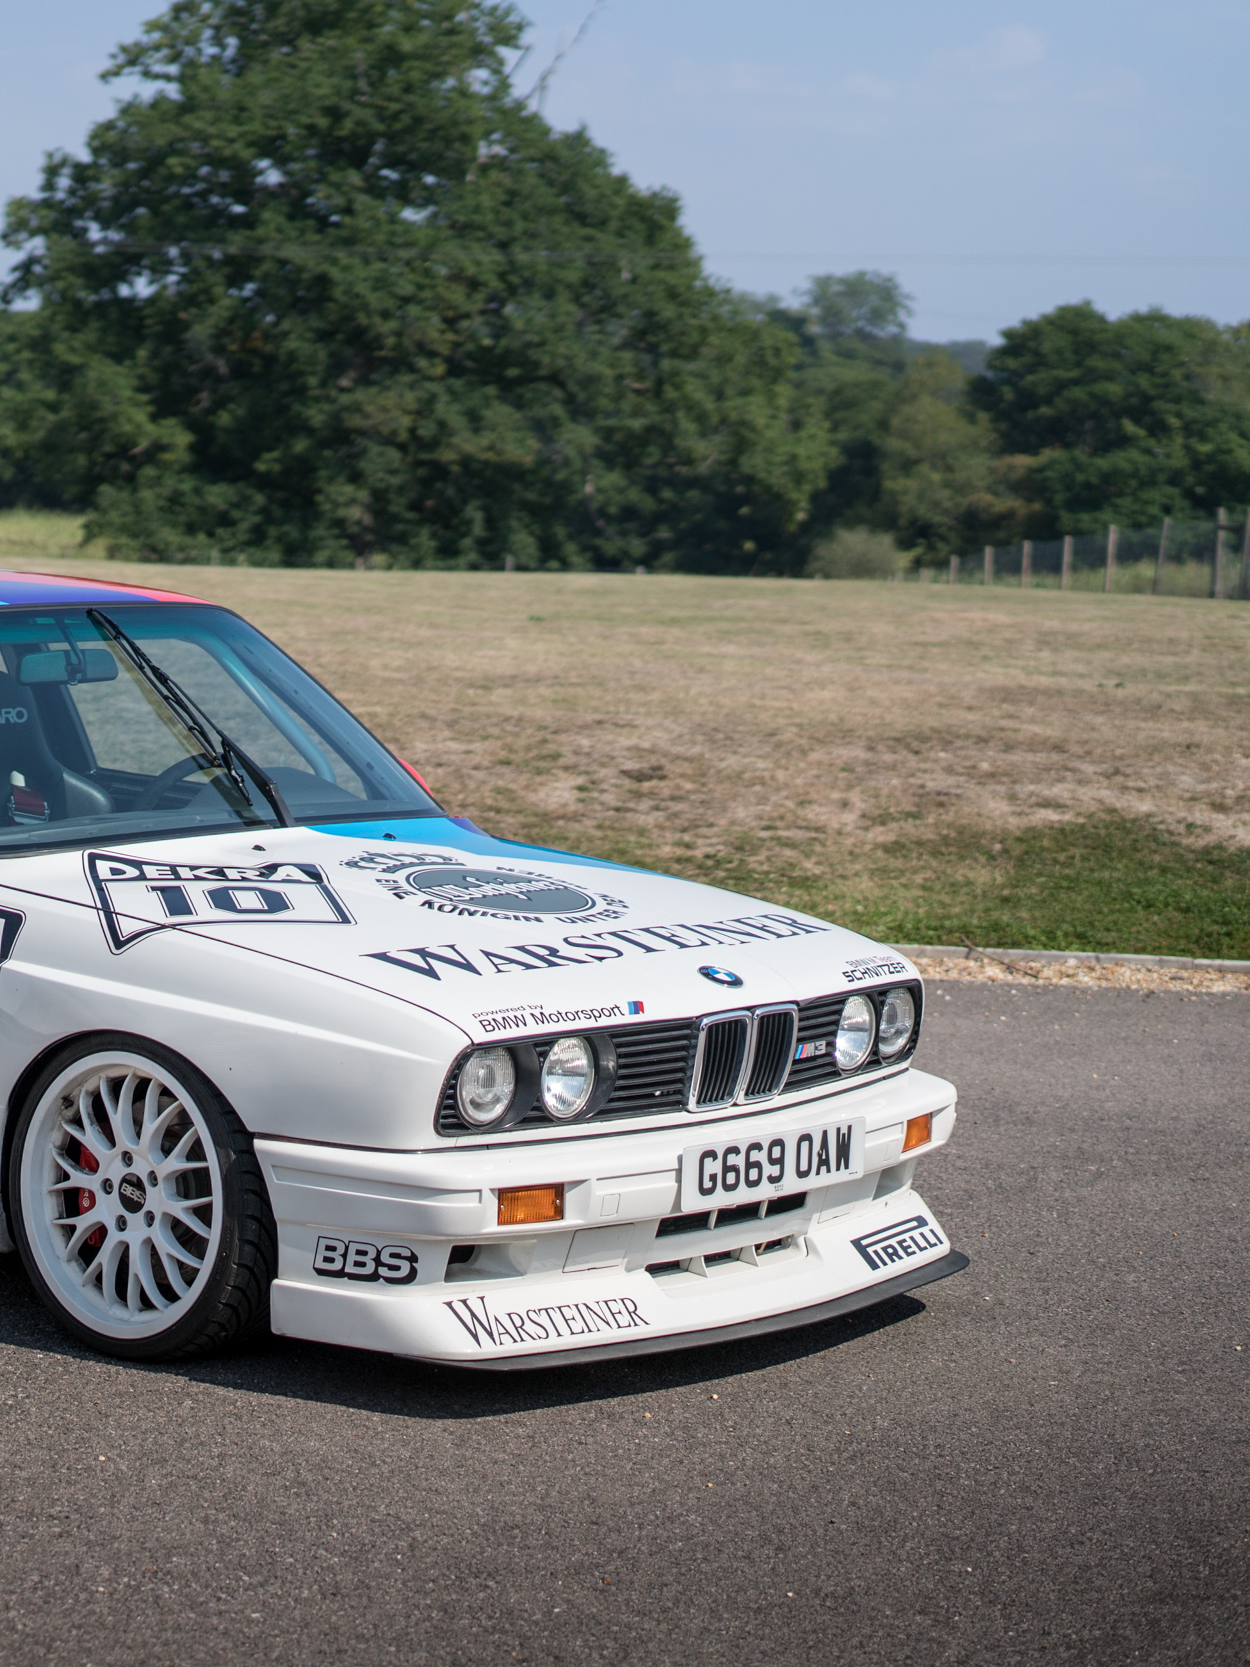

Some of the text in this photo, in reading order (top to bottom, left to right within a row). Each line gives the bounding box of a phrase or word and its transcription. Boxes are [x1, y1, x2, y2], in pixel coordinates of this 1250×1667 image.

[95, 859, 318, 884] DEKRA
[145, 884, 295, 918] 10
[359, 913, 832, 981] WARSTEINER
[842, 962, 908, 983] SCHNITZER
[471, 1005, 526, 1019] powered
[478, 1004, 625, 1033] BMW Motorsport
[804, 1040, 827, 1058] M3
[698, 1124, 853, 1197] G669 OAW
[120, 1182, 146, 1205] BBS
[850, 1215, 944, 1271] PIRELLI
[313, 1235, 419, 1285] BBS
[442, 1295, 651, 1350] WARSTEINER
